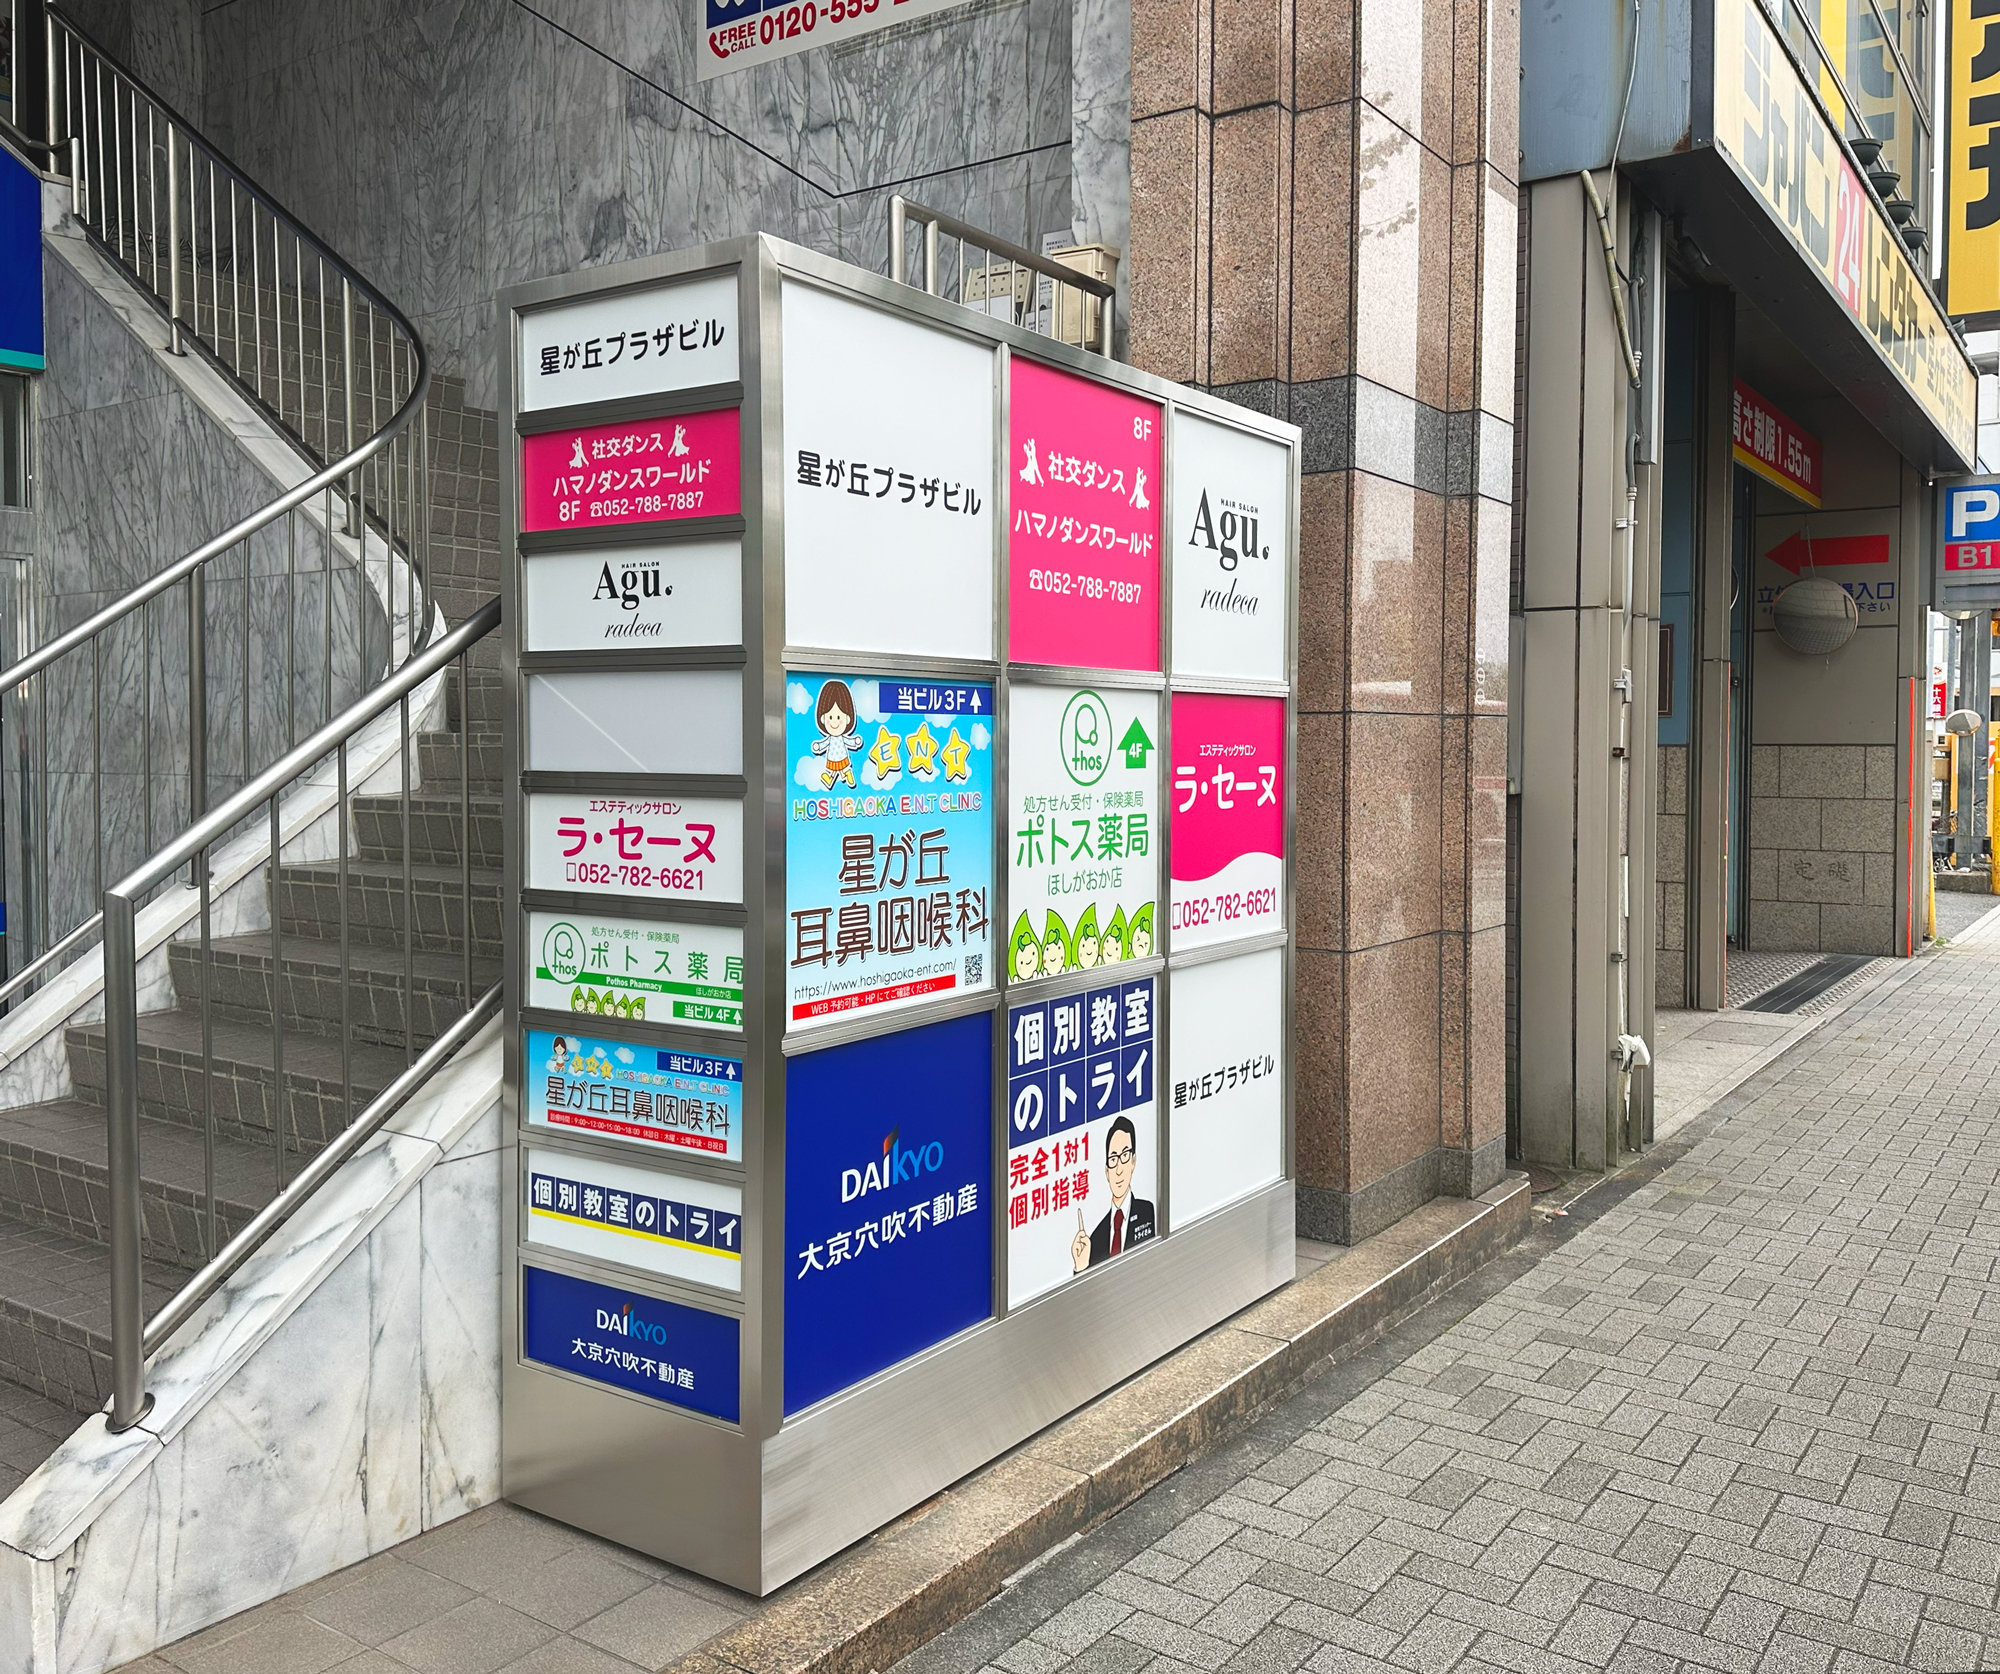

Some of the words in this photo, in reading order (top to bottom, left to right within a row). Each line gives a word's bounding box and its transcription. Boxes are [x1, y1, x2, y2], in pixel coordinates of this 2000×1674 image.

[719, 21, 756, 46] FREE
[731, 37, 756, 53] CALL
[540, 319, 725, 376] 星が丘プラザビル
[591, 433, 664, 460] 社交ダンス
[1133, 416, 1152, 442] 8F
[553, 459, 711, 497] ハマノダンスワールド
[797, 449, 981, 516] 星が丘プラザビル
[1048, 450, 1126, 495] 社交ダンス
[559, 500, 581, 521] 8F
[603, 491, 704, 517] 052-788-7887
[1220, 498, 1236, 509] HAIR
[1239, 502, 1259, 515] SALON
[1952, 489, 2000, 537] P
[1015, 509, 1154, 557] ハマノダンスワールド
[1188, 486, 1270, 571] Agu.
[1958, 545, 1992, 568] B1
[592, 561, 673, 610] Agu.
[1044, 569, 1142, 604] 052-788-7887
[1200, 578, 1260, 616] radeca
[604, 613, 663, 639] radeca
[1129, 743, 1143, 758] 4F
[1199, 744, 1257, 757] エステティックサロン
[589, 800, 682, 815] エステティックサロン
[794, 796, 898, 821] HOSHIGAOKA
[939, 792, 982, 812] CLINIC
[1023, 790, 1144, 814] 処方せん受付・保険薬局
[1175, 763, 1276, 813] ラ・セーヌ
[557, 817, 716, 864] ラ・セーヌ
[1017, 813, 1149, 868] ポトス薬局
[578, 862, 703, 891] 052-782-6621
[838, 827, 951, 896] 星が丘
[1047, 866, 1123, 896] ほしがおか店
[790, 886, 990, 968] 耳鼻咽喉科
[1182, 887, 1276, 928] 052-782-6621
[591, 926, 680, 945] 処方せん受付・保険薬局
[591, 941, 744, 985] ポトス薬局
[794, 957, 957, 1000] https://www.hoshigaoka-ent.com/
[606, 976, 628, 988] Pothos
[629, 979, 663, 993] Pharmacy
[695, 987, 732, 1000] ほしがおか店
[811, 1003, 829, 1016] WEB
[1013, 987, 1150, 1066] 個別教室
[699, 1082, 730, 1096] CLINIC
[1014, 1048, 1149, 1132] のトライ
[1174, 1054, 1275, 1109] 星が丘プラザビル
[546, 1075, 730, 1136] 星が丘耳鼻咽喉科
[1010, 1132, 1090, 1189] 完全1対1
[533, 1177, 738, 1247] 個別教室のトライ
[1009, 1168, 1090, 1230] 個別指導
[798, 1182, 978, 1280] 大京穴吹不動産
[571, 1337, 695, 1390] 大京穴吹不動産
